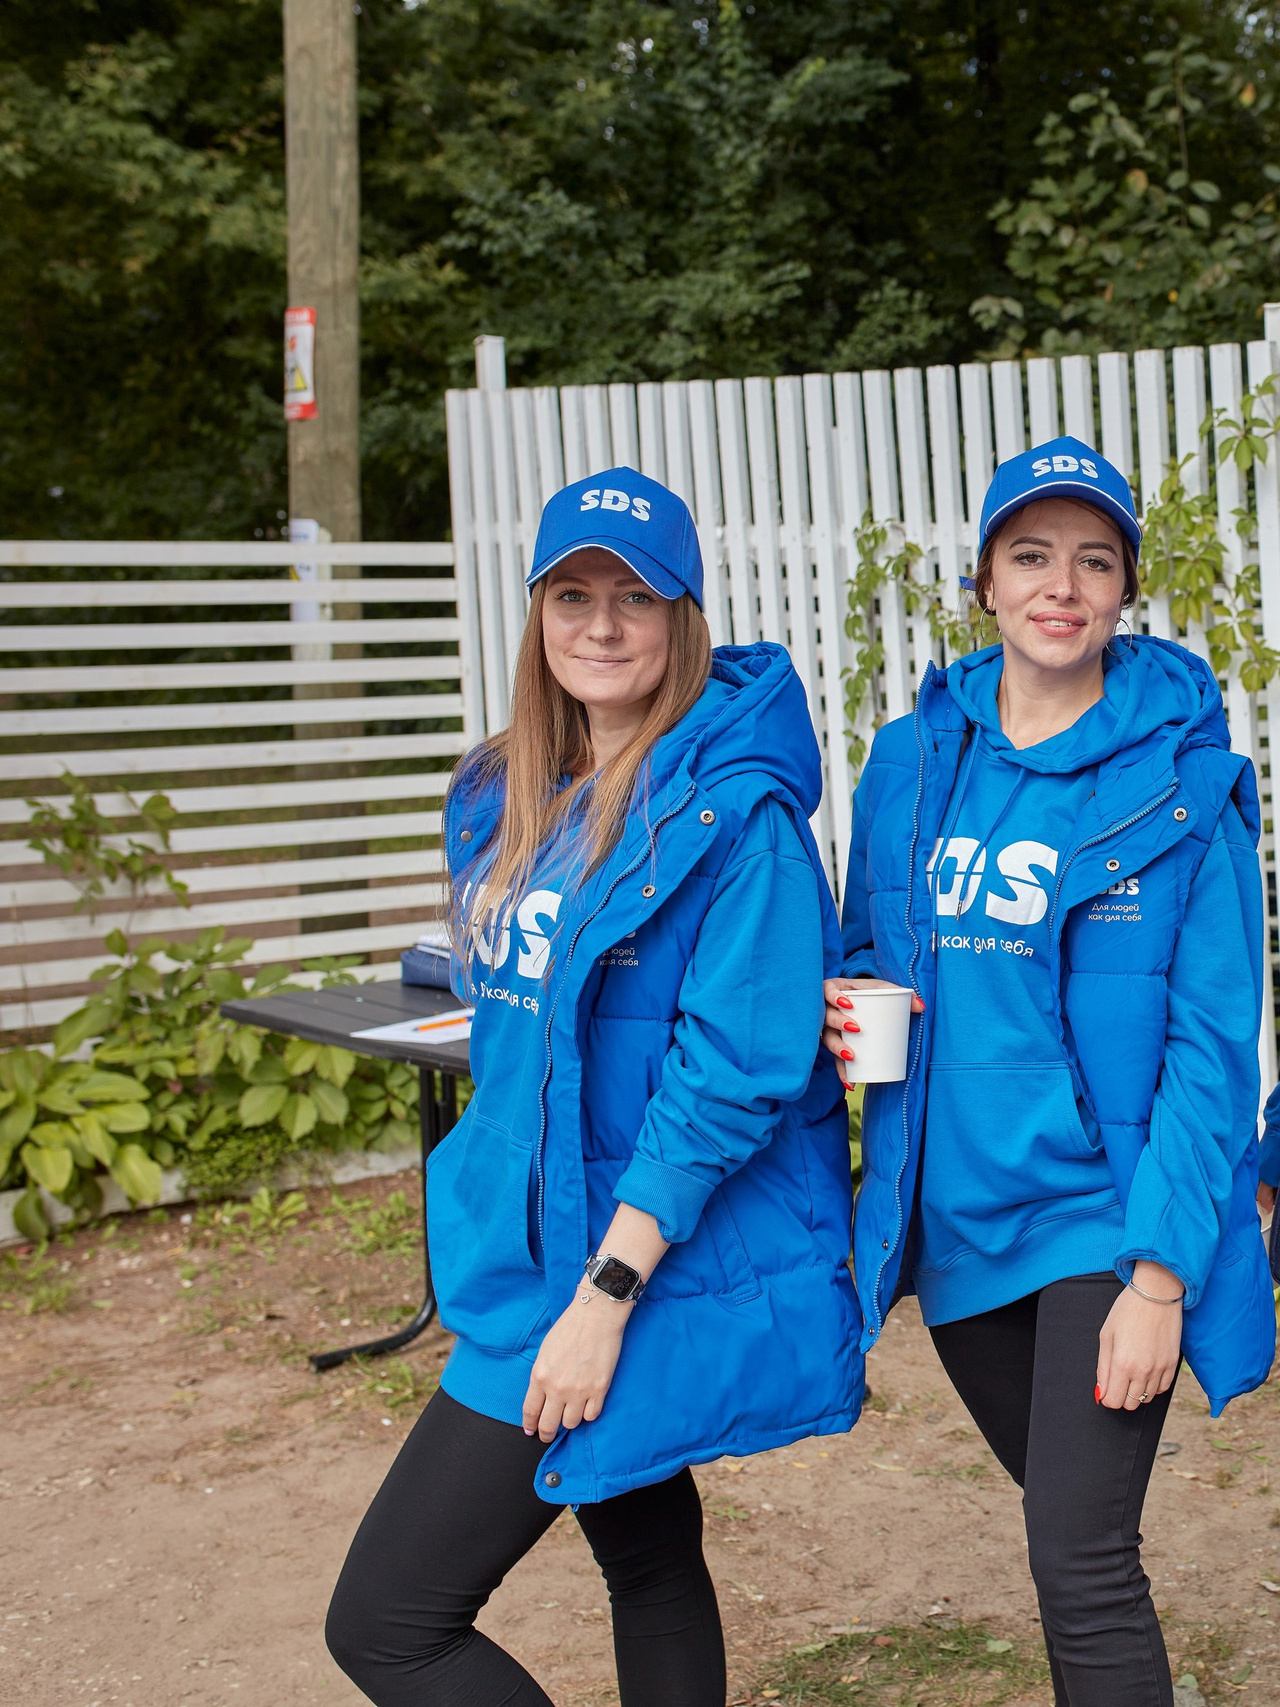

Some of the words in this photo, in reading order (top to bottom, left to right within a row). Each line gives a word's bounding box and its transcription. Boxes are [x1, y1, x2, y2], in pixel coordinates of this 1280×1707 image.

[1031, 455, 1099, 479] SDS
[580, 489, 651, 521] SDS
[1099, 878, 1140, 896] DS
[1091, 902, 1109, 912] Для
[1110, 903, 1140, 913] людей
[1104, 914, 1121, 923] для
[1122, 913, 1142, 922] себя
[611, 947, 635, 957] юдей
[941, 935, 971, 949] как
[974, 936, 996, 954] для
[1000, 938, 1034, 957] себя
[617, 957, 639, 966] себя
[486, 987, 510, 1001] как
